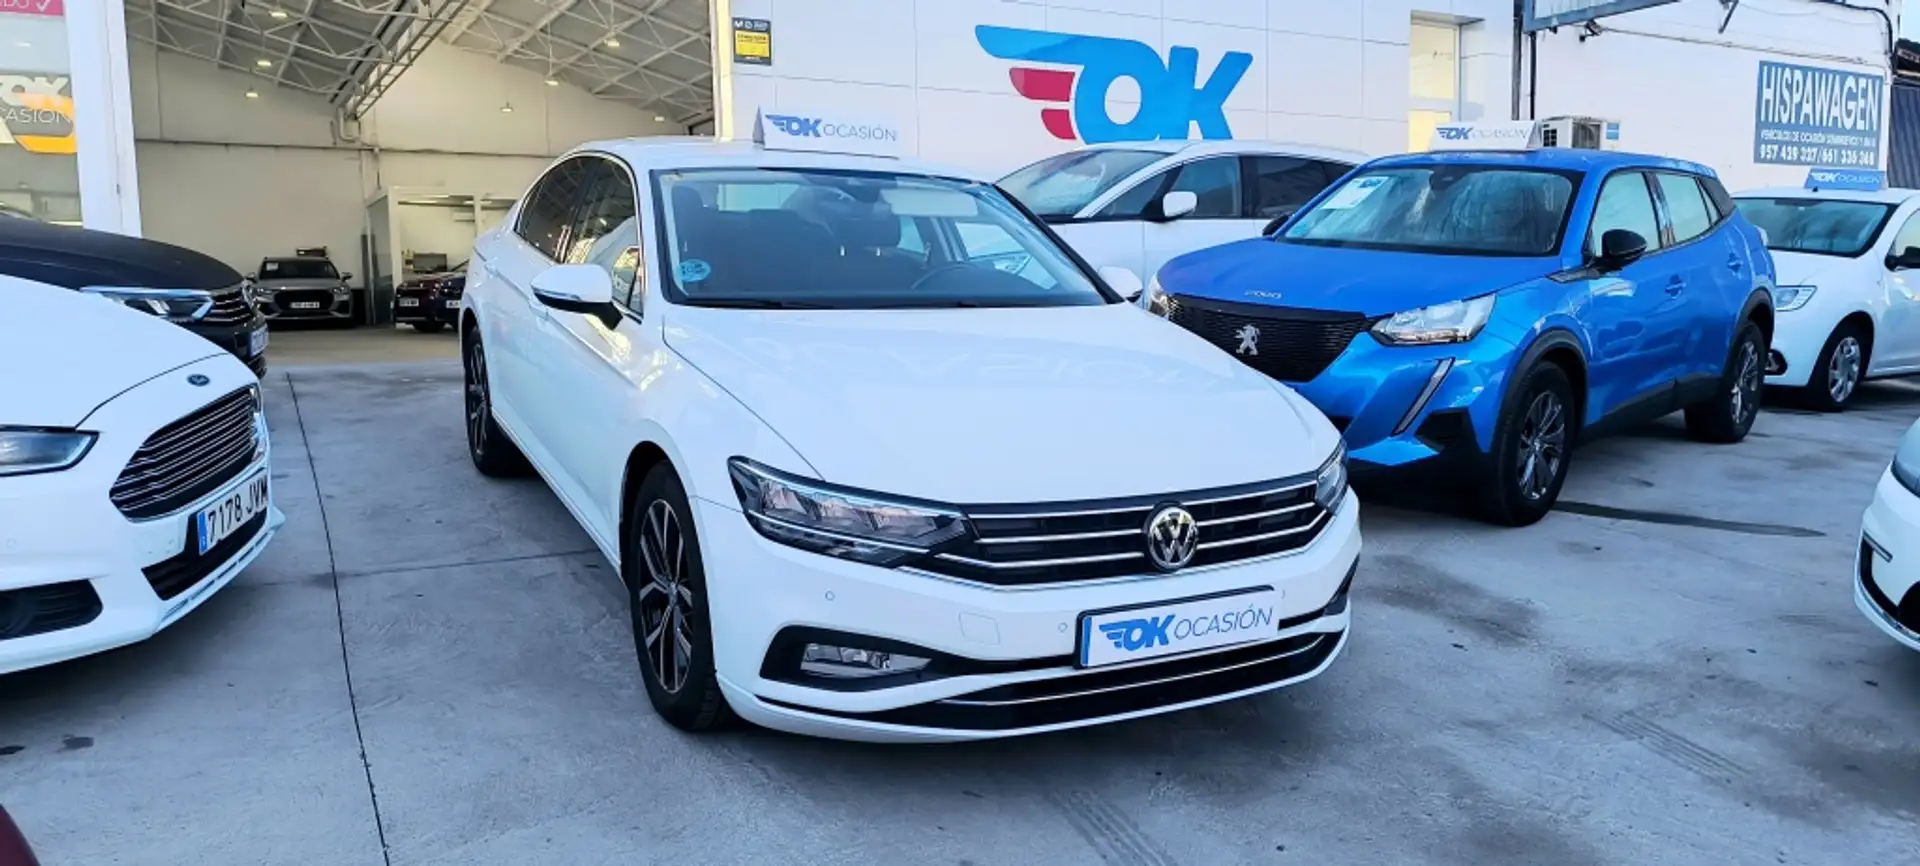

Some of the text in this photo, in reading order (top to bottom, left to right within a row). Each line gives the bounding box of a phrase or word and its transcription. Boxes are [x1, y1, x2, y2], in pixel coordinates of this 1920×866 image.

[1074, 38, 1254, 145] OK
[1761, 66, 1879, 131] HISPAWAGEN
[785, 117, 897, 142] OK OCASIÓN
[1446, 127, 1473, 140] OK
[208, 492, 243, 543] 7178
[1123, 603, 1273, 651] OK OCASIÓN
